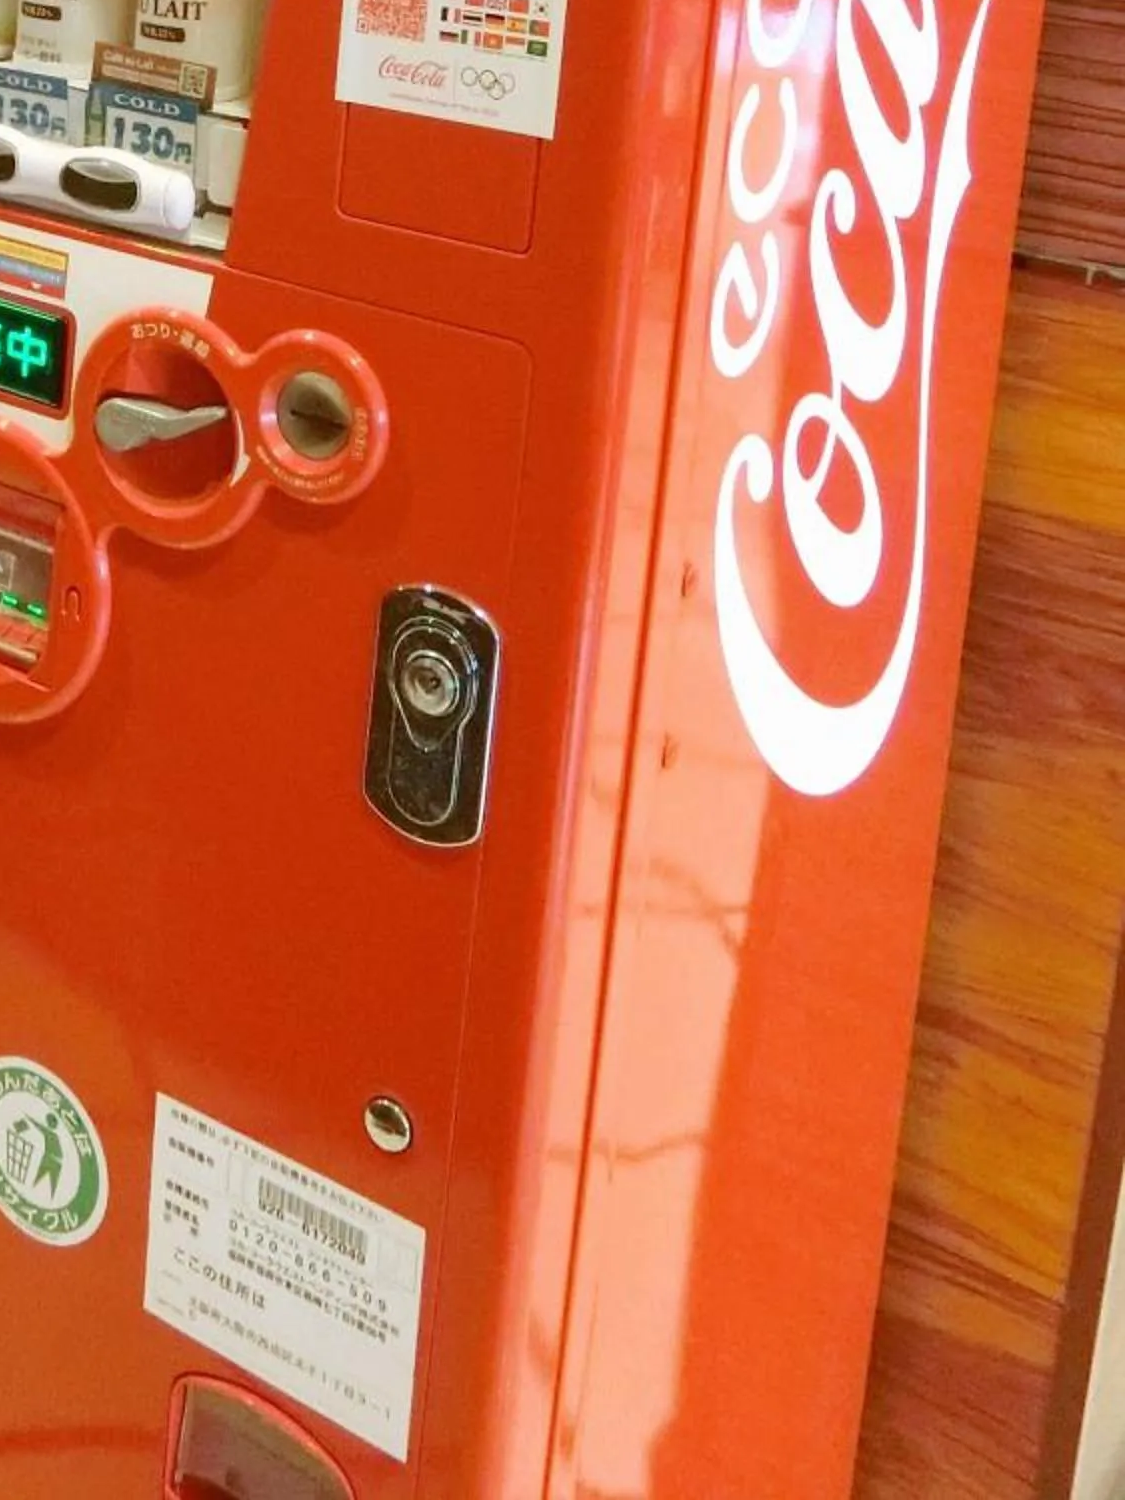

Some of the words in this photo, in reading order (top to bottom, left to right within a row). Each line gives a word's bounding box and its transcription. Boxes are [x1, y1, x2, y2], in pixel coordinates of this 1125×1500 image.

[378, 54, 450, 88] Coca-Cola
[113, 93, 181, 117] COLD
[113, 117, 194, 166] 130円
[173, 1249, 266, 1311] ここの住所は
